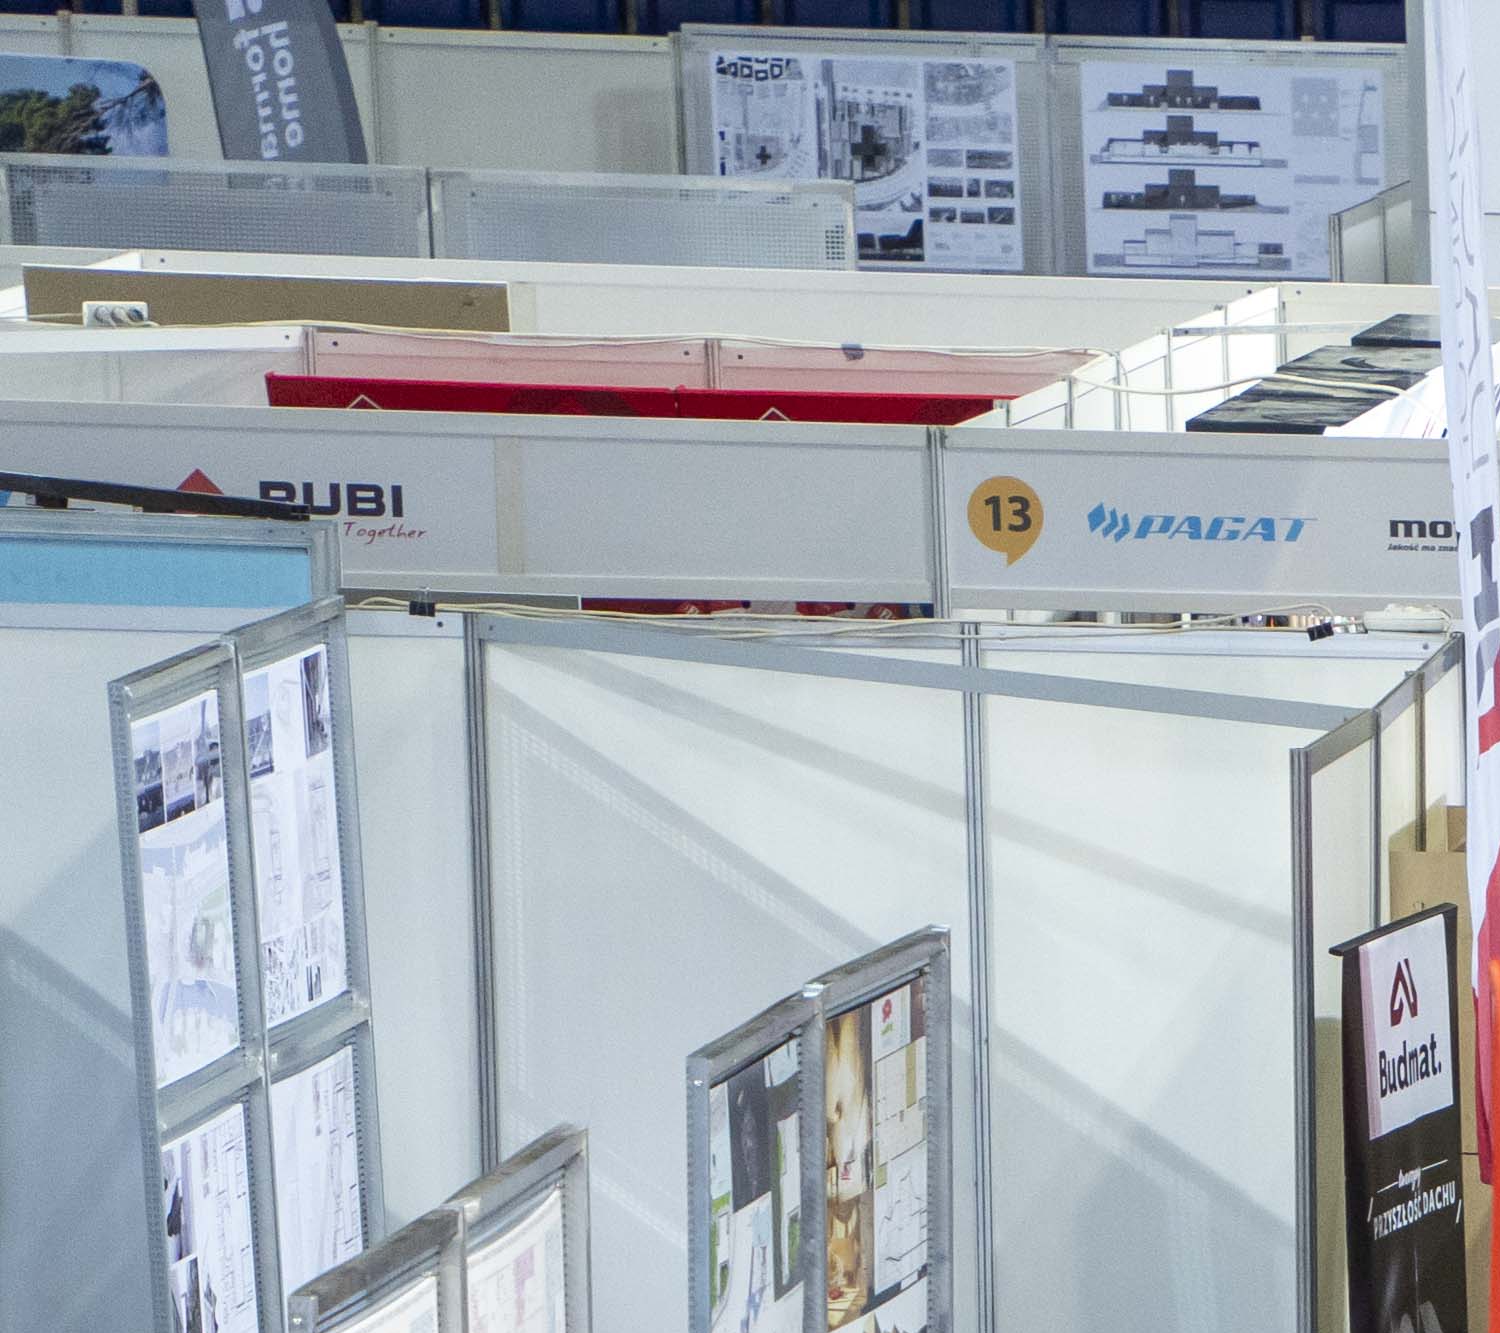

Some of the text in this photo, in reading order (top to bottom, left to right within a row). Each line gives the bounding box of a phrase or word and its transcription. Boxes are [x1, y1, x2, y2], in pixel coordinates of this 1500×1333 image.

[259, 480, 404, 518] RUBI
[984, 495, 1033, 533] 13
[343, 521, 428, 545] Together
[1133, 514, 1319, 542] PAGAT
[1379, 1033, 1443, 1099] Budmat.
[1422, 1180, 1456, 1216] DACHU
